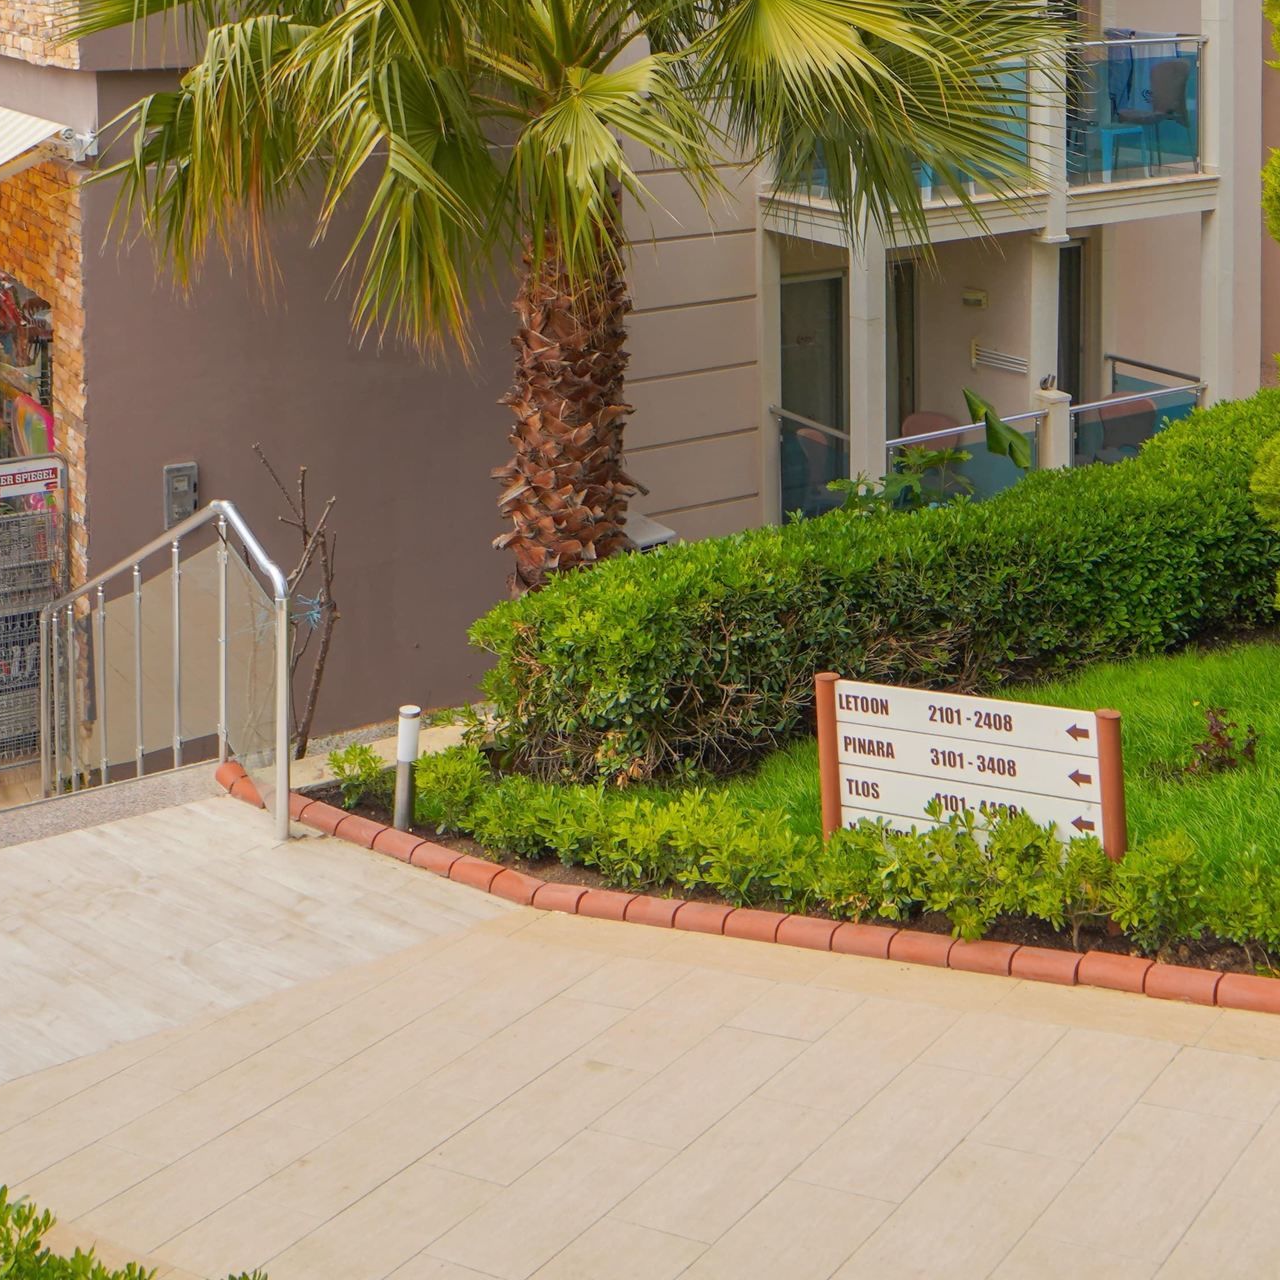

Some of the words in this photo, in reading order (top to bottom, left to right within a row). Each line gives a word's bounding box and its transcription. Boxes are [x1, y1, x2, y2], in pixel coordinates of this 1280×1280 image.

[15, 469, 55, 484] SPIEGEL
[839, 693, 889, 716] LETOON
[928, 704, 961, 726] 2101
[974, 710, 1013, 732] 2408
[843, 735, 895, 759] PINARA
[930, 748, 964, 769] 3101
[976, 754, 1016, 777] 3408
[846, 778, 880, 799] TLOS
